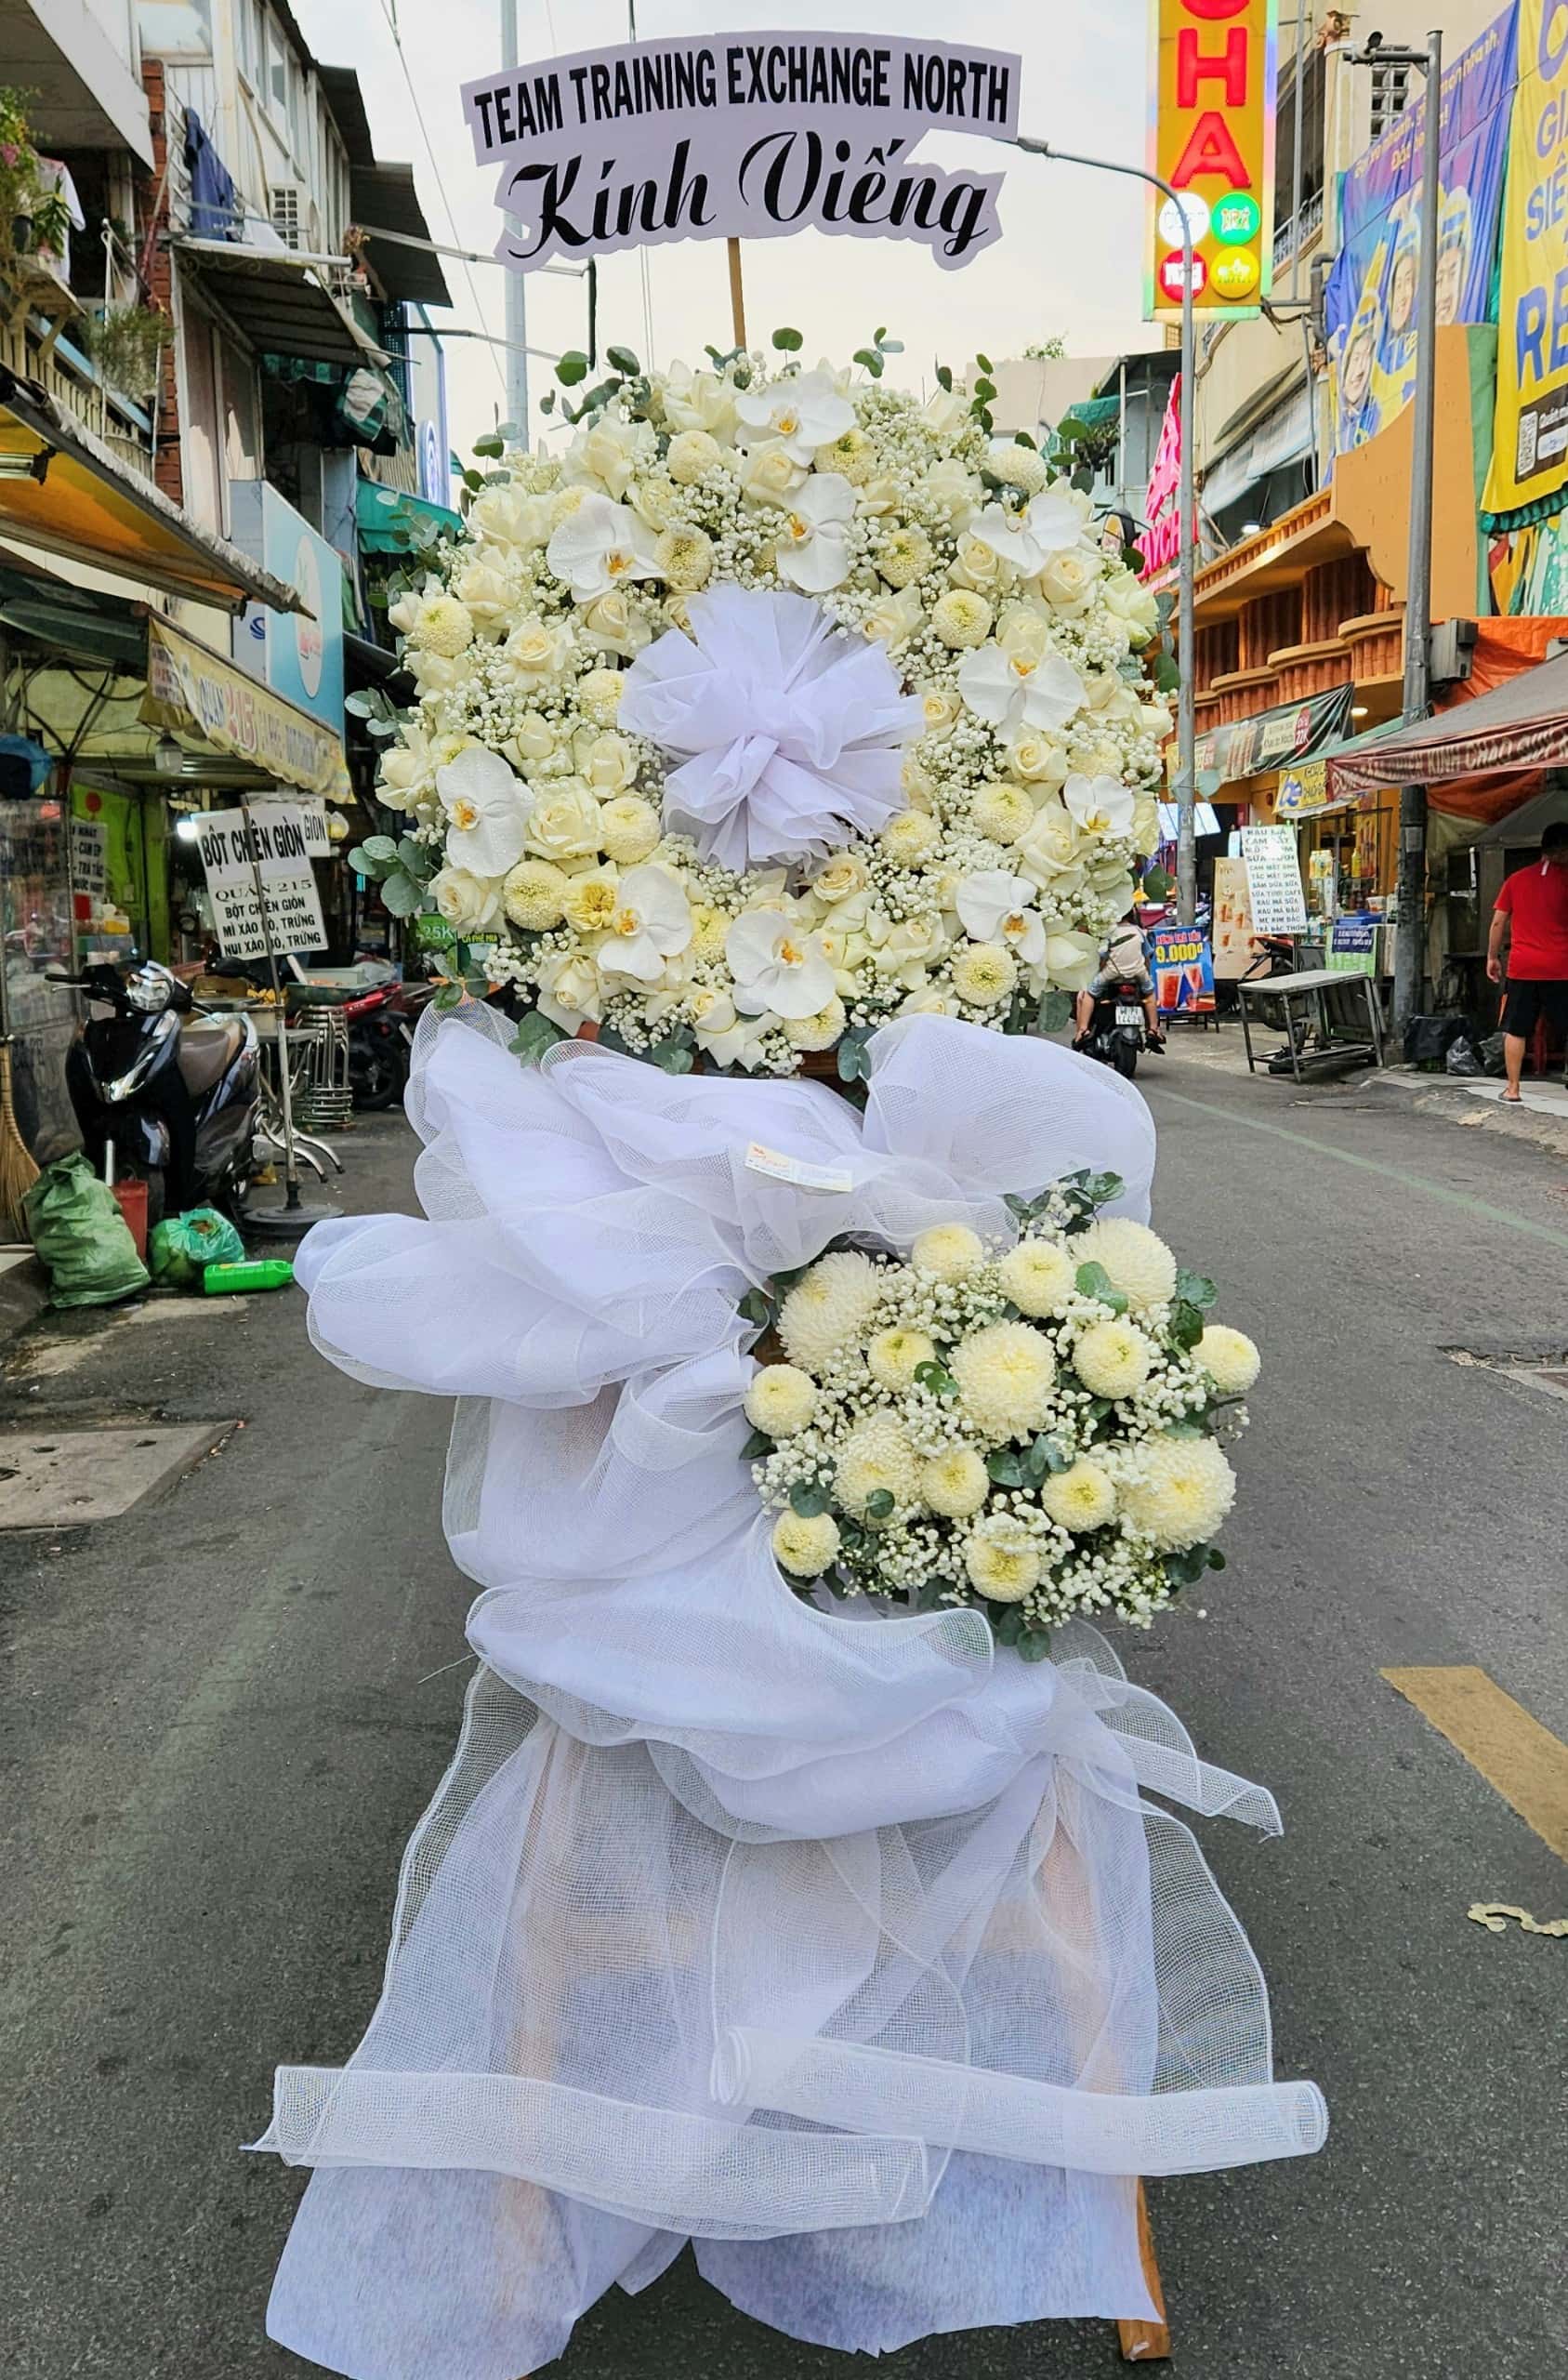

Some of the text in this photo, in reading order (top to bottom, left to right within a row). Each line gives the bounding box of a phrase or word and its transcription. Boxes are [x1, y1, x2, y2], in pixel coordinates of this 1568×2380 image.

[474, 45, 1010, 149] TEAM TRAINING EXCHANGE NORTH
[1170, 0, 1252, 189] HA
[507, 131, 990, 259] Kính Viếng
[201, 815, 307, 874] BỘT CHÊN GIÒN
[279, 879, 313, 892] 215
[223, 922, 236, 938] MÌ
[238, 919, 259, 936] XÀO
[281, 912, 315, 929] TRỨNG
[225, 895, 306, 920] BỘT CHÊN GIÒN
[224, 943, 243, 958] NUI
[244, 937, 265, 953] XÀO
[286, 930, 322, 946] TRỨNG
